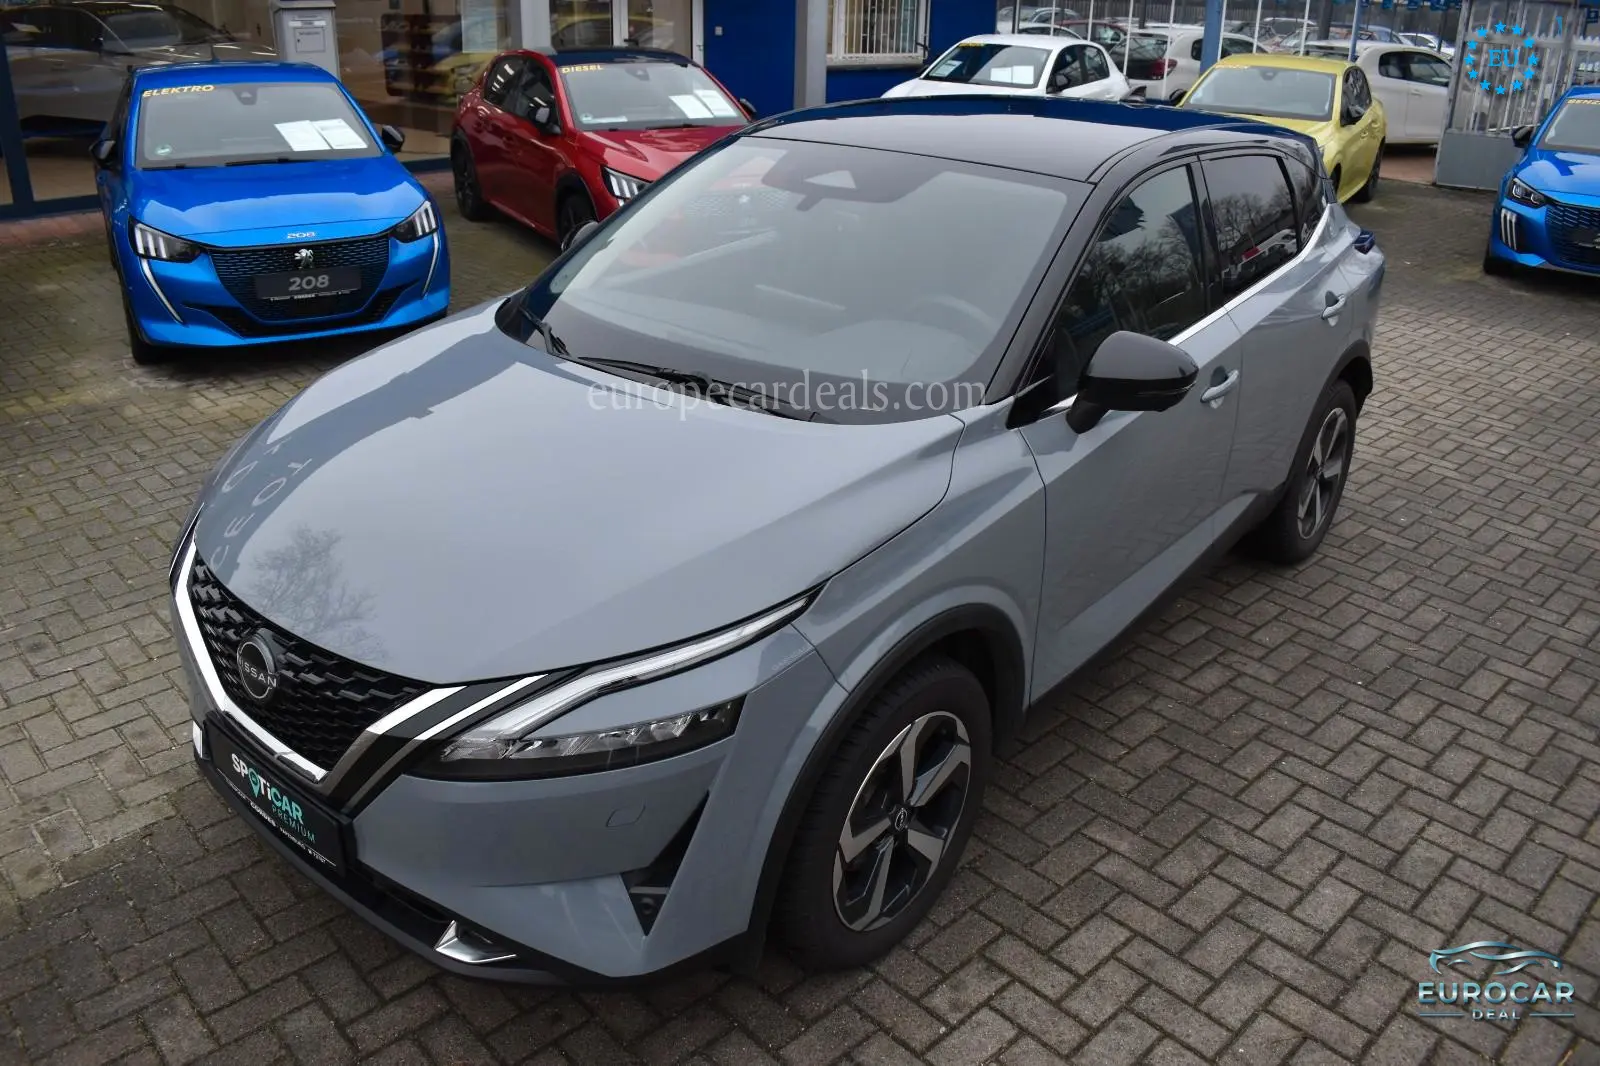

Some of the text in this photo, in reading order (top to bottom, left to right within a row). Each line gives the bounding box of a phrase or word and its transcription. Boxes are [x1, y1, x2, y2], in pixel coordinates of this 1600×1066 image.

[561, 64, 604, 74] DIESEL
[142, 84, 216, 97] ELEKTRO
[287, 231, 316, 239] 208
[288, 274, 330, 291] 208
[272, 804, 316, 844] PREMIUM
